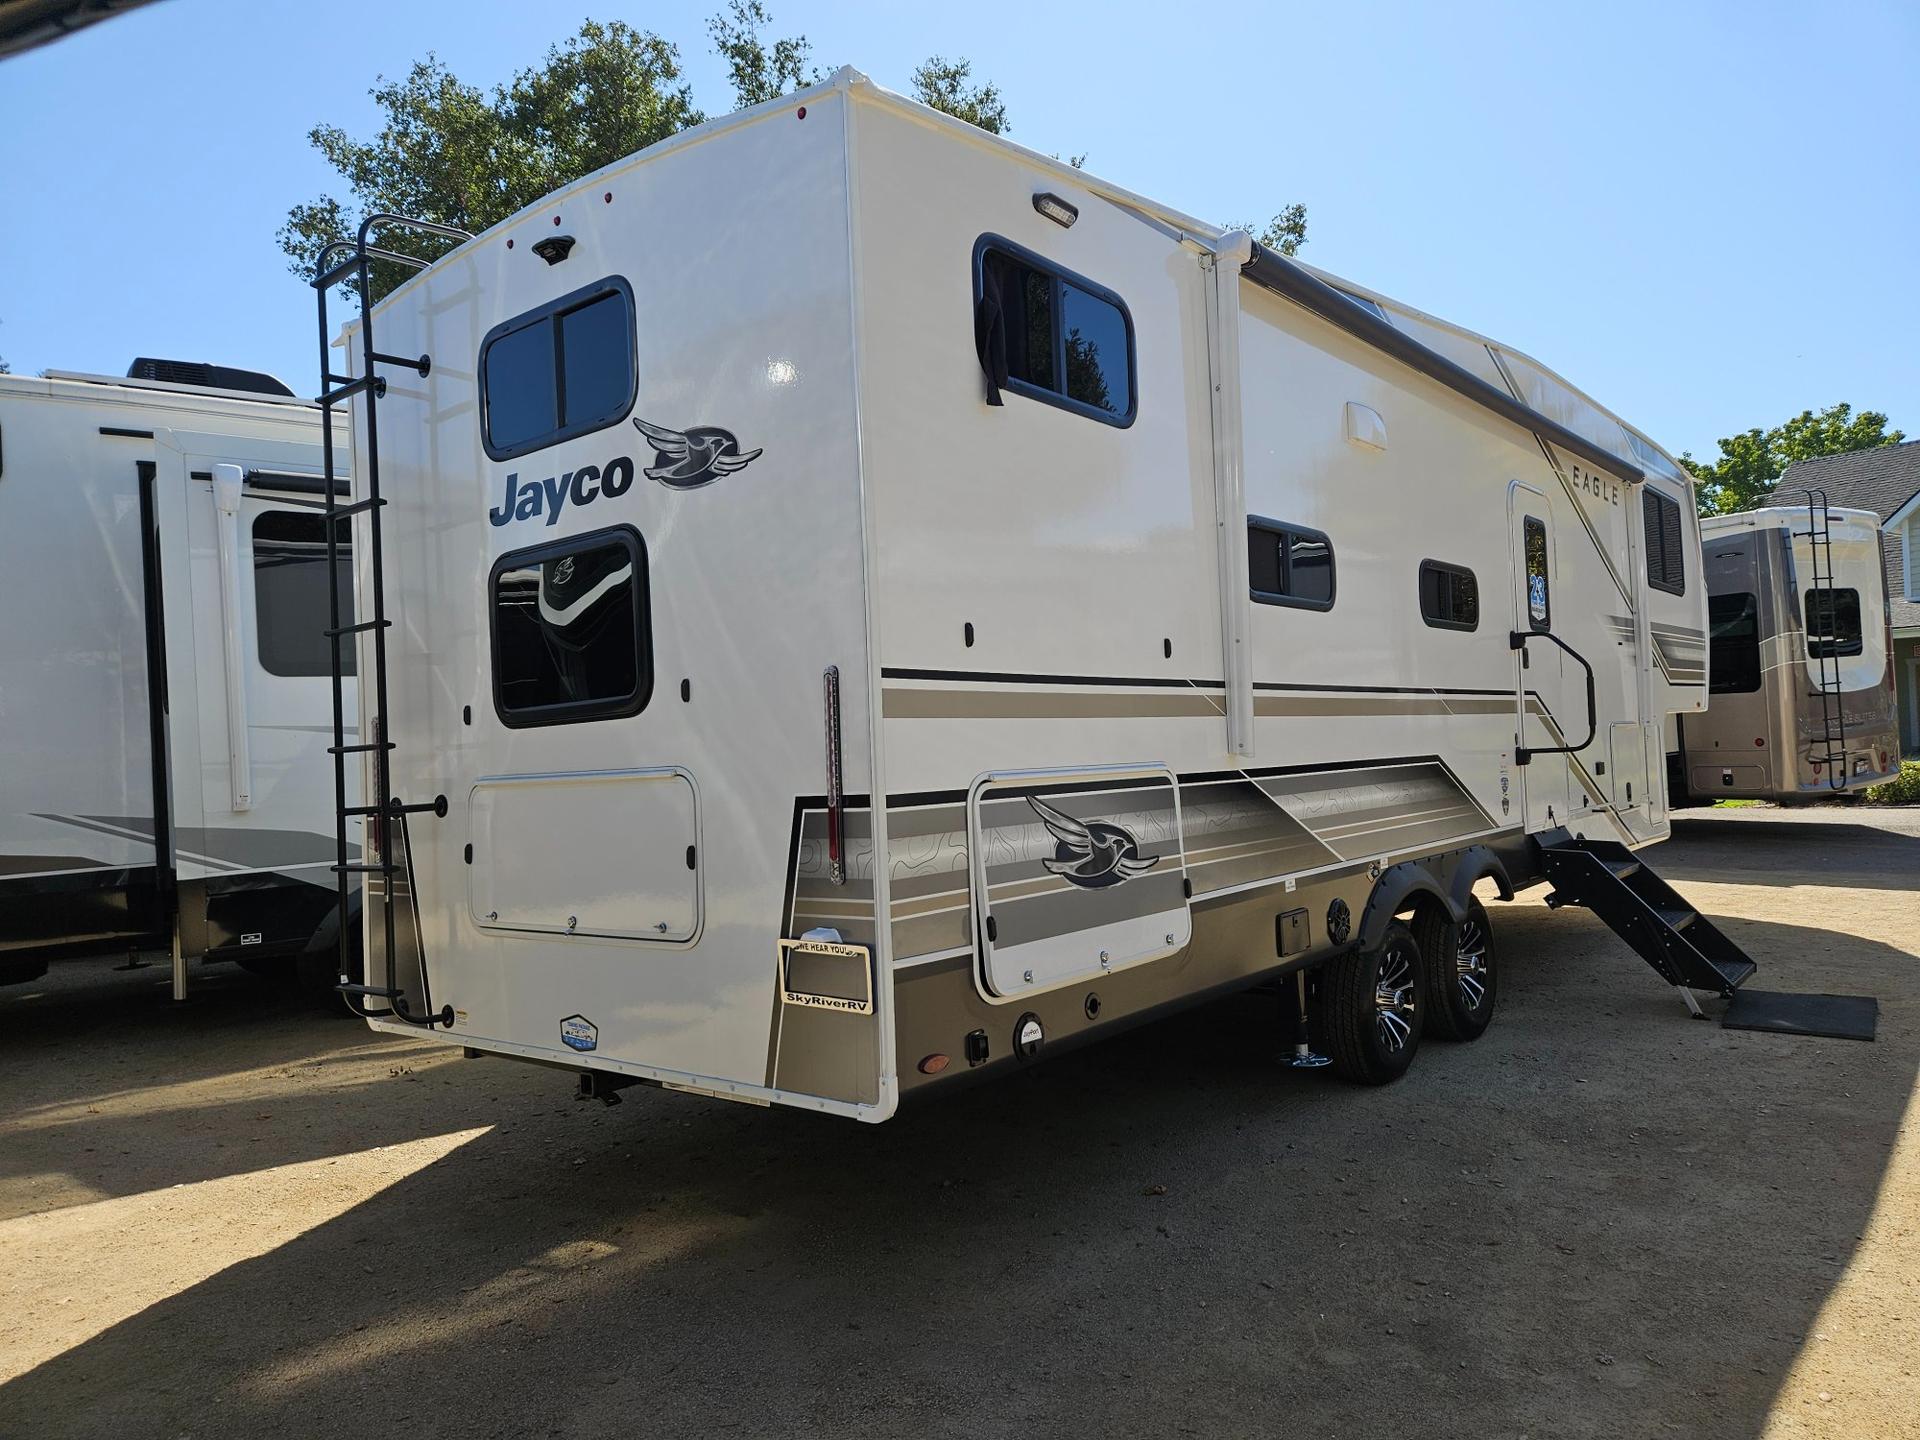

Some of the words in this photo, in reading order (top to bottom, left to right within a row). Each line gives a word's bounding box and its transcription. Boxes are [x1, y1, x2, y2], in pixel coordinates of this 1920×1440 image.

[489, 456, 634, 527] Jayco
[1572, 465, 1618, 506] EAGLE
[810, 943, 829, 953] HEAR
[787, 993, 867, 1010] SkyRiverRV
